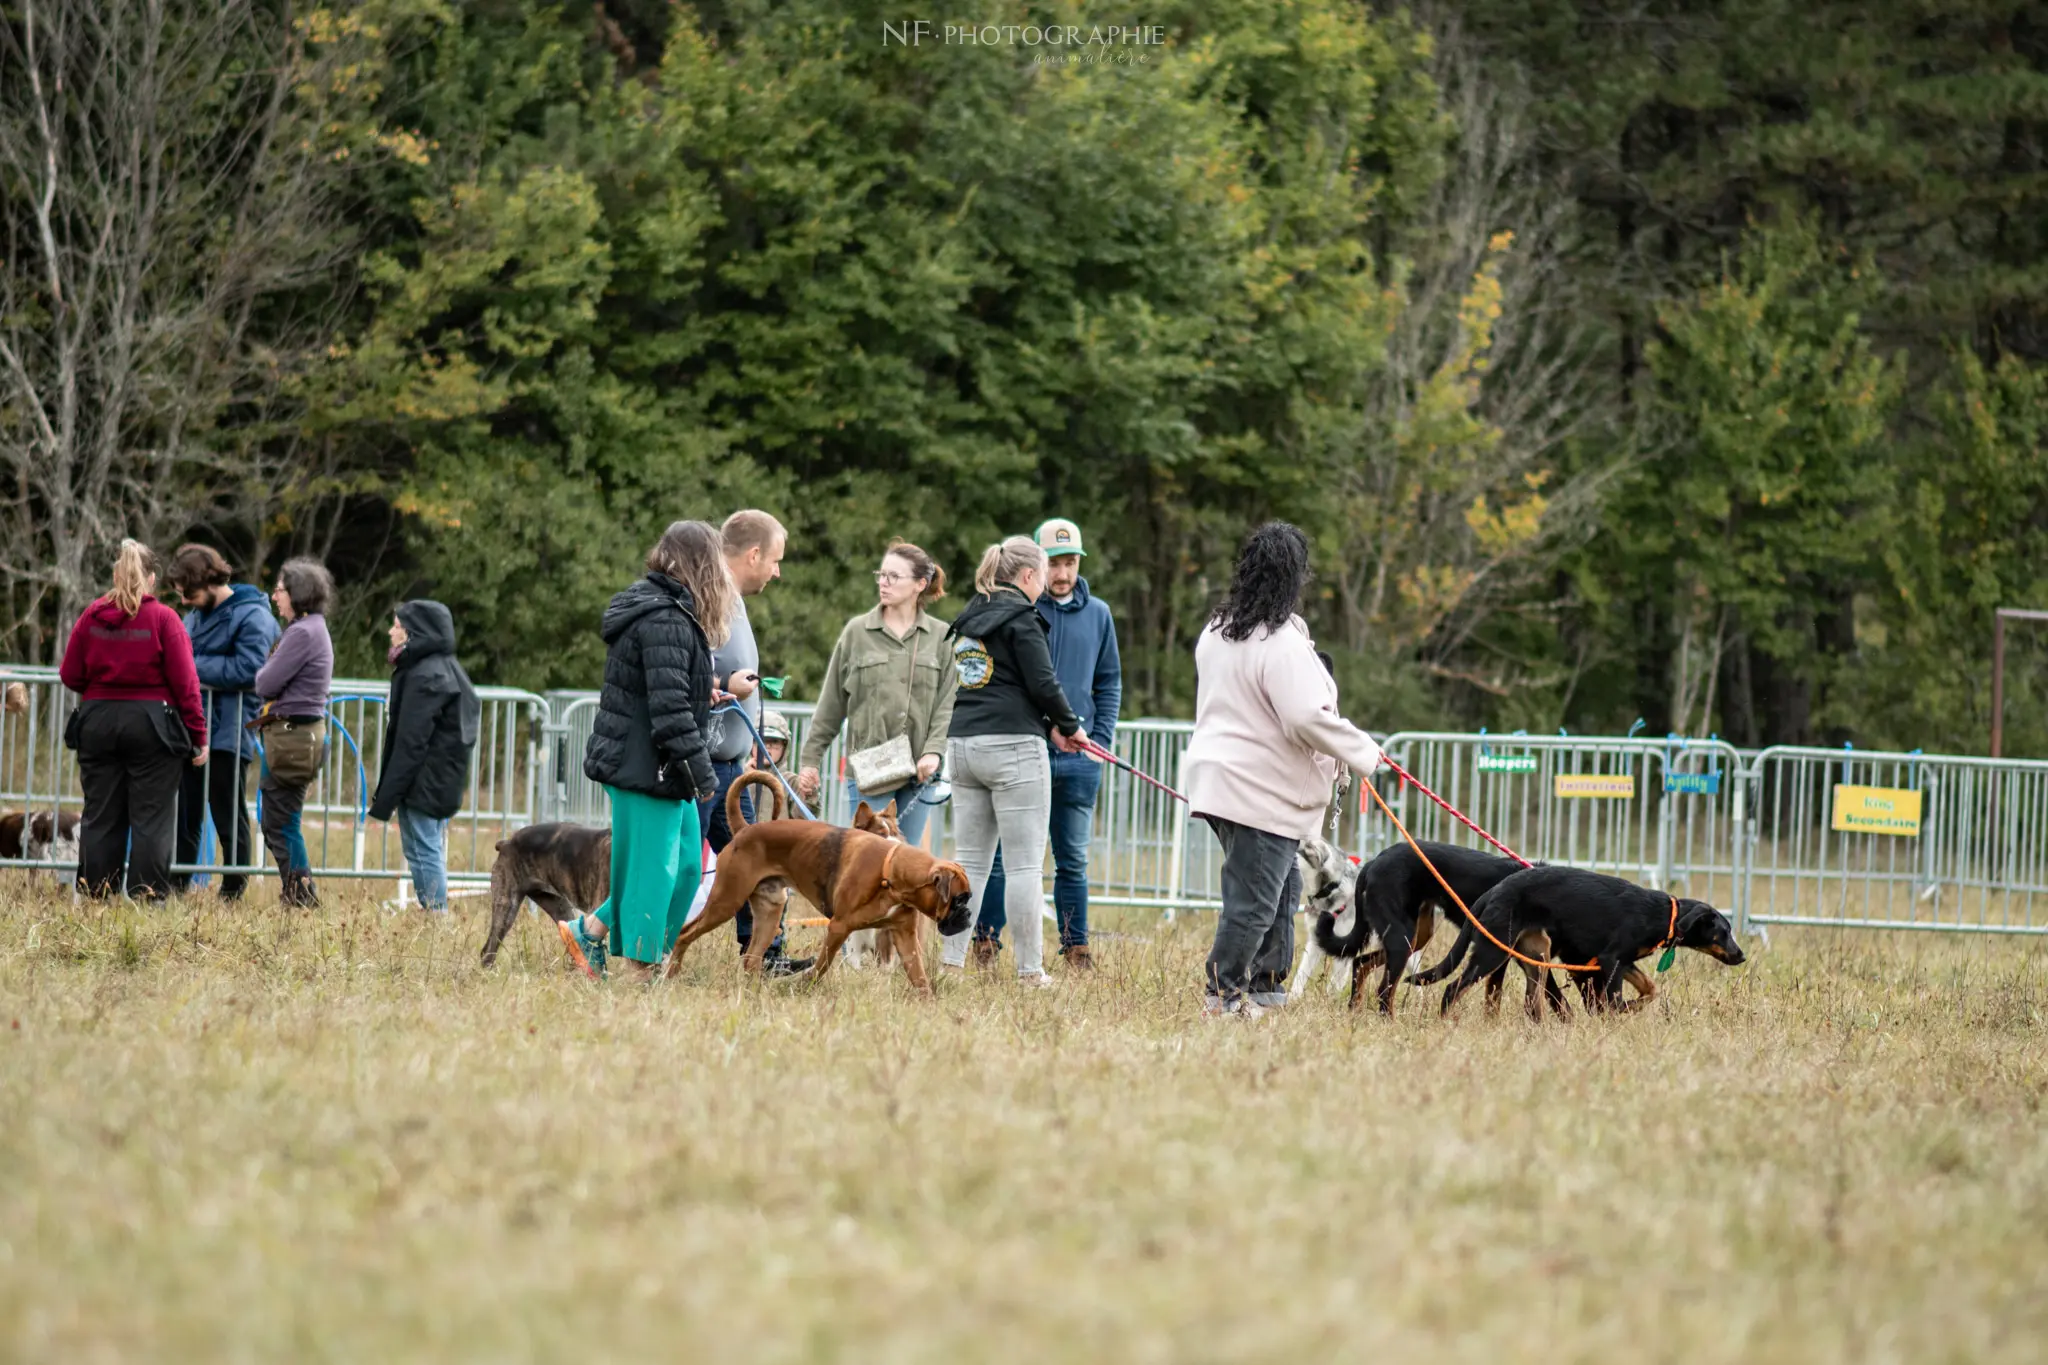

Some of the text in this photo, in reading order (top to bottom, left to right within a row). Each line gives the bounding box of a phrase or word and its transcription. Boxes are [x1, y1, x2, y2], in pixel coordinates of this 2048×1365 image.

[1479, 756, 1536, 770] Hoopers
[1667, 774, 1708, 793] Agility
[1864, 796, 1894, 811] Ring
[1846, 813, 1917, 828] Secondaire
